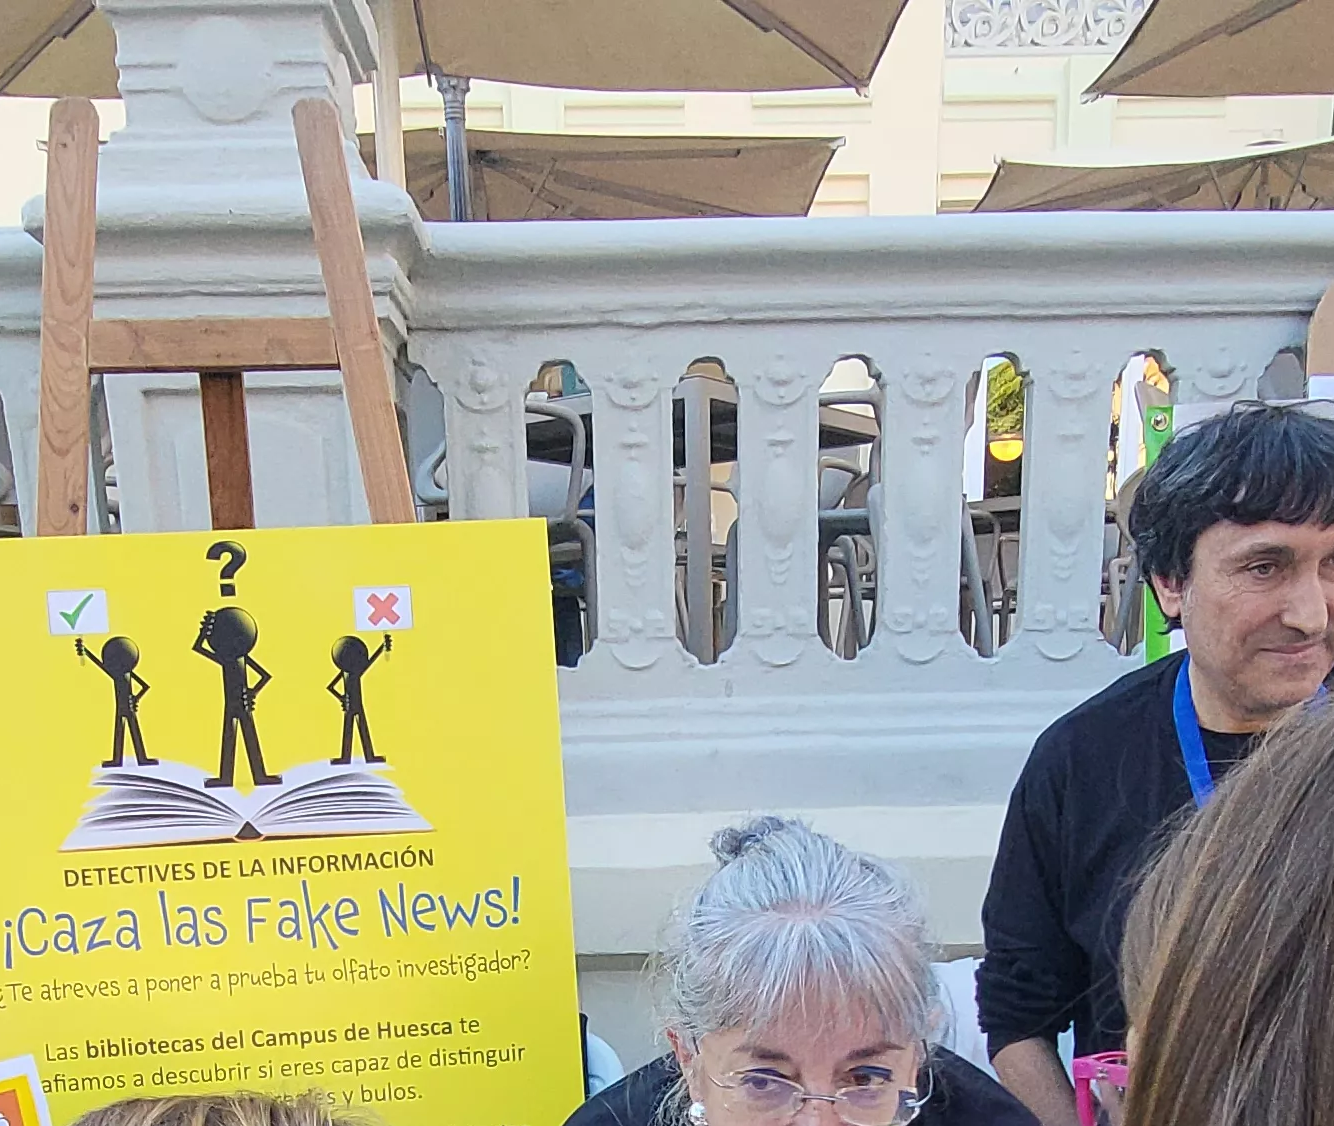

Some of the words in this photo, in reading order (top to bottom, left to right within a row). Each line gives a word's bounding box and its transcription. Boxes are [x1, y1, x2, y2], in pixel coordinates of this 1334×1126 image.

[64, 864, 196, 888] DETECTIVES
[203, 861, 231, 880] DE
[239, 859, 265, 878] LA
[272, 845, 434, 876] INFORMACIÓN
[3, 907, 142, 969] ¡Caza
[159, 890, 228, 947] las
[246, 879, 360, 950] Fake
[377, 876, 521, 937] News!
[40, 977, 120, 1002] atreves
[128, 979, 142, 996] a
[146, 972, 203, 1001] poner
[210, 974, 222, 992] a
[229, 961, 298, 999] prueba
[304, 963, 326, 985] tu
[331, 957, 392, 982] olfato
[396, 948, 531, 983] investigador?
[45, 1043, 79, 1062] Las
[86, 1036, 205, 1059] bibliotecas
[212, 1030, 245, 1050] del
[251, 1026, 337, 1049] Campus
[344, 1023, 370, 1042] de
[378, 1019, 453, 1040] Huesca
[459, 1016, 481, 1034] te
[42, 1073, 126, 1094] afiamos
[133, 1073, 145, 1088] a
[151, 1063, 252, 1086] descubrir
[259, 1060, 273, 1079] si
[280, 1062, 325, 1078] eres
[331, 1055, 391, 1076] capaz
[397, 1050, 422, 1070] de
[429, 1044, 526, 1068] distinguir
[361, 1082, 423, 1103] bulos.
